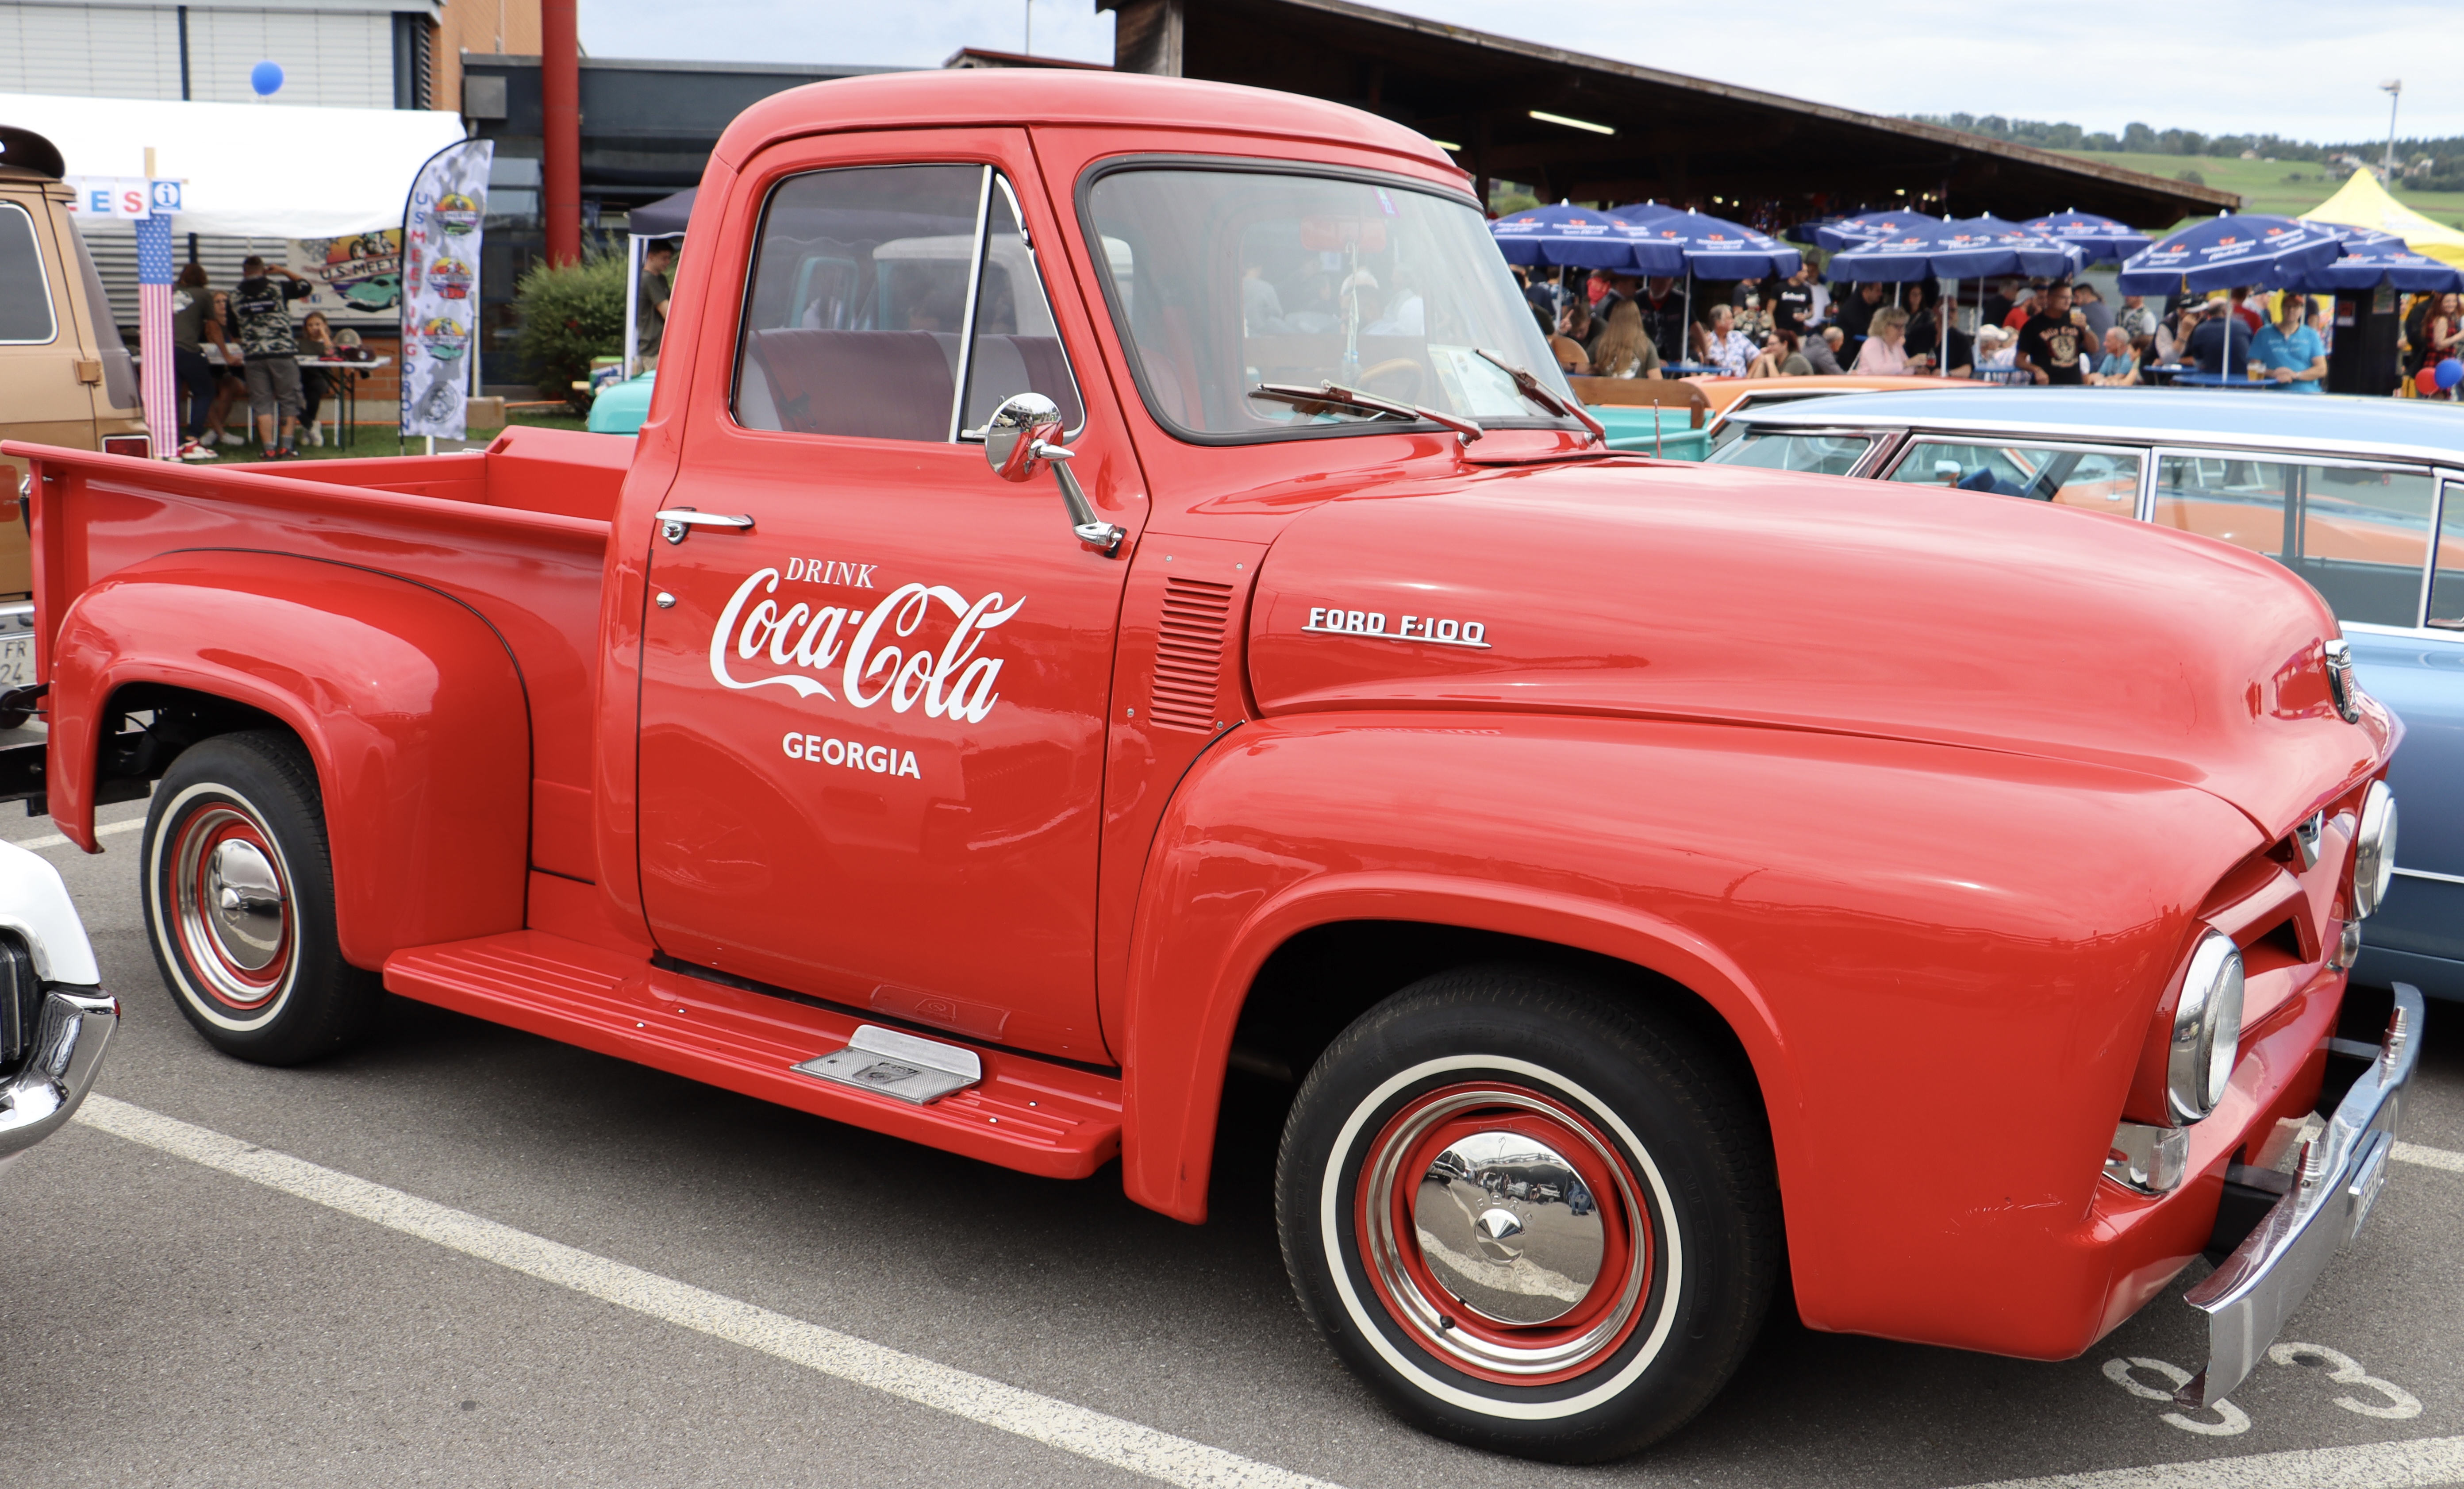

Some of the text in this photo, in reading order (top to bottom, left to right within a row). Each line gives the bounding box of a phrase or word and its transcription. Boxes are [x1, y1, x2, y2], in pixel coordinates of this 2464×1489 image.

[784, 557, 877, 588] DRINK
[1309, 607, 1386, 633] FORD
[5, 641, 27, 658] FR
[710, 567, 1027, 723] Coca-Cola
[782, 731, 921, 779] GEORGIA
[1475, 1191, 1535, 1224] FORD
[1676, 1168, 1712, 1313] ALL SEASON
